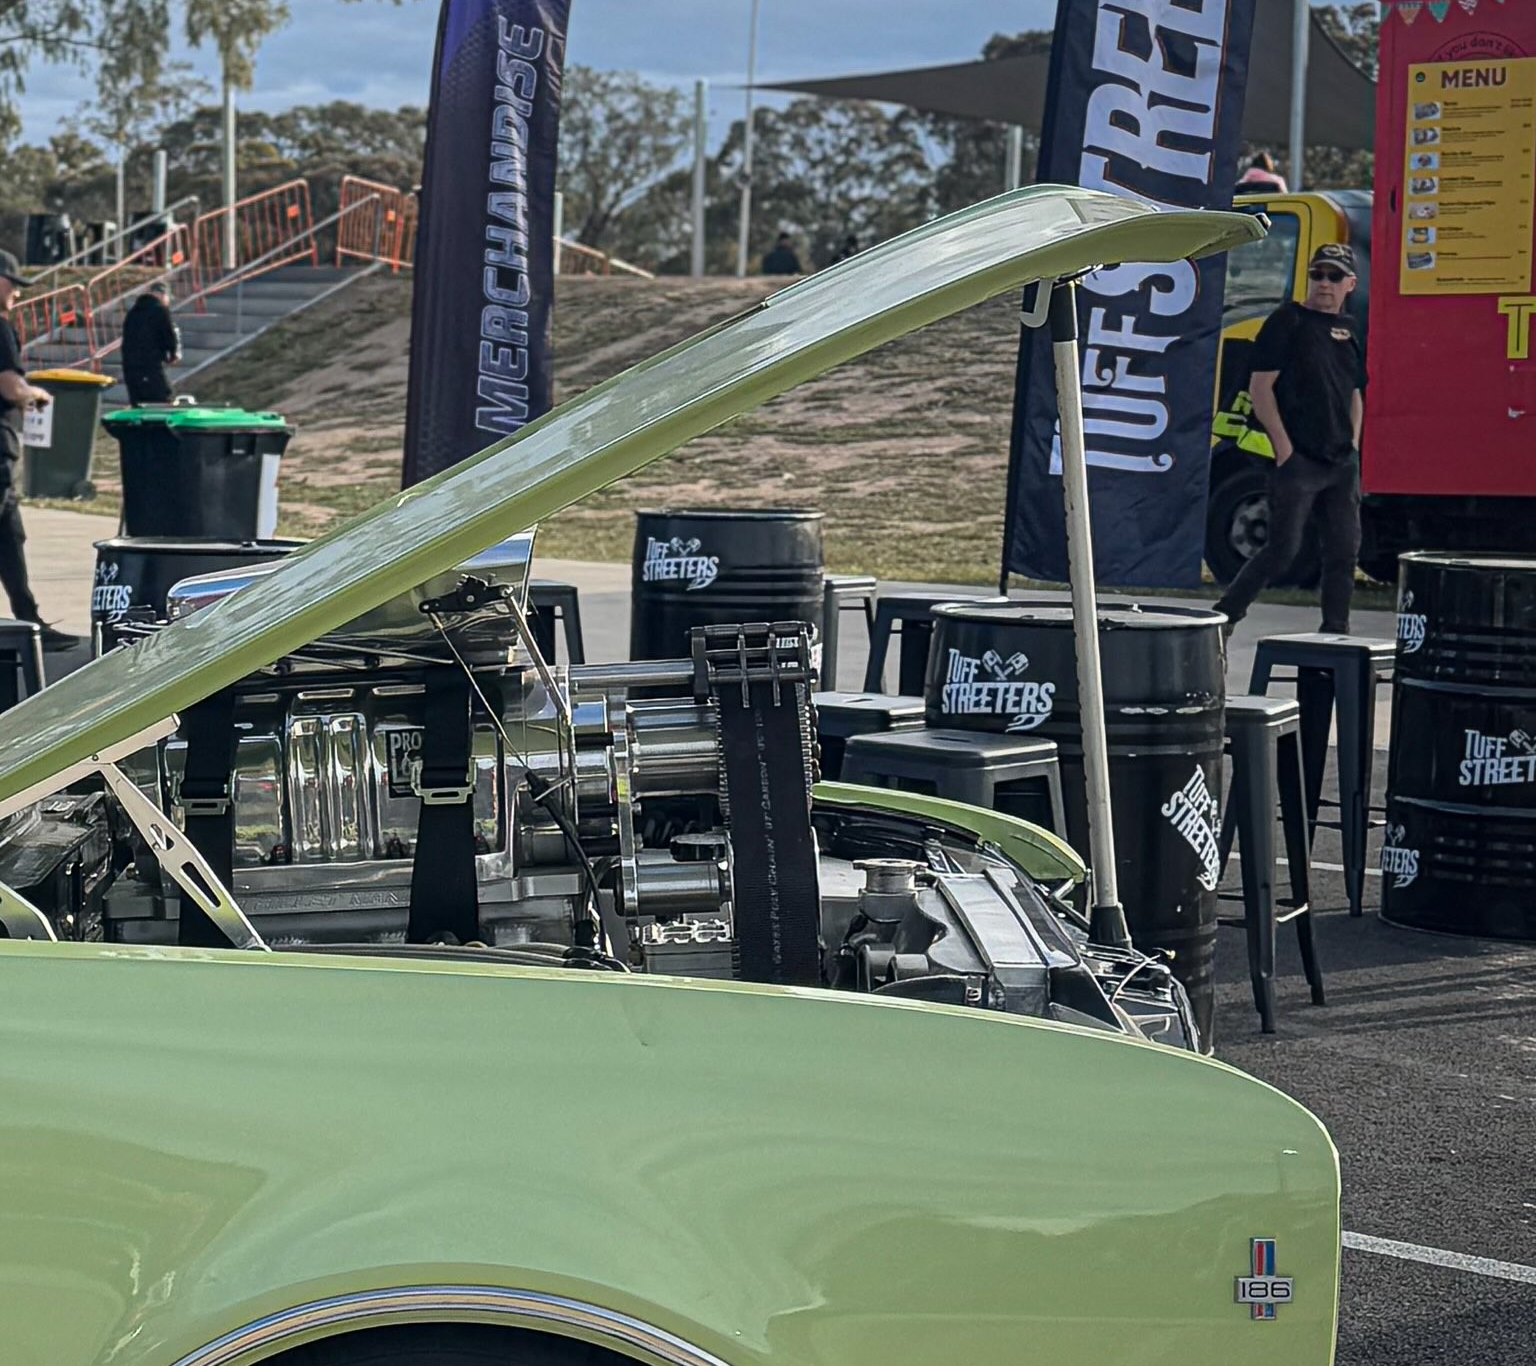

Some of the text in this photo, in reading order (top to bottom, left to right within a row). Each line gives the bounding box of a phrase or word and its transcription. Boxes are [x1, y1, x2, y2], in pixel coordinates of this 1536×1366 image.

[1441, 67, 1507, 89] MENU
[475, 16, 544, 435] MERCHANDISE
[646, 537, 670, 561] TUFF
[642, 556, 720, 582] STREETERS
[946, 648, 981, 683] TUFF
[941, 682, 1056, 714] STREETERS
[1465, 729, 1508, 759] TUFF
[1459, 756, 1536, 786] STREET
[1241, 1281, 1291, 1299] 186
